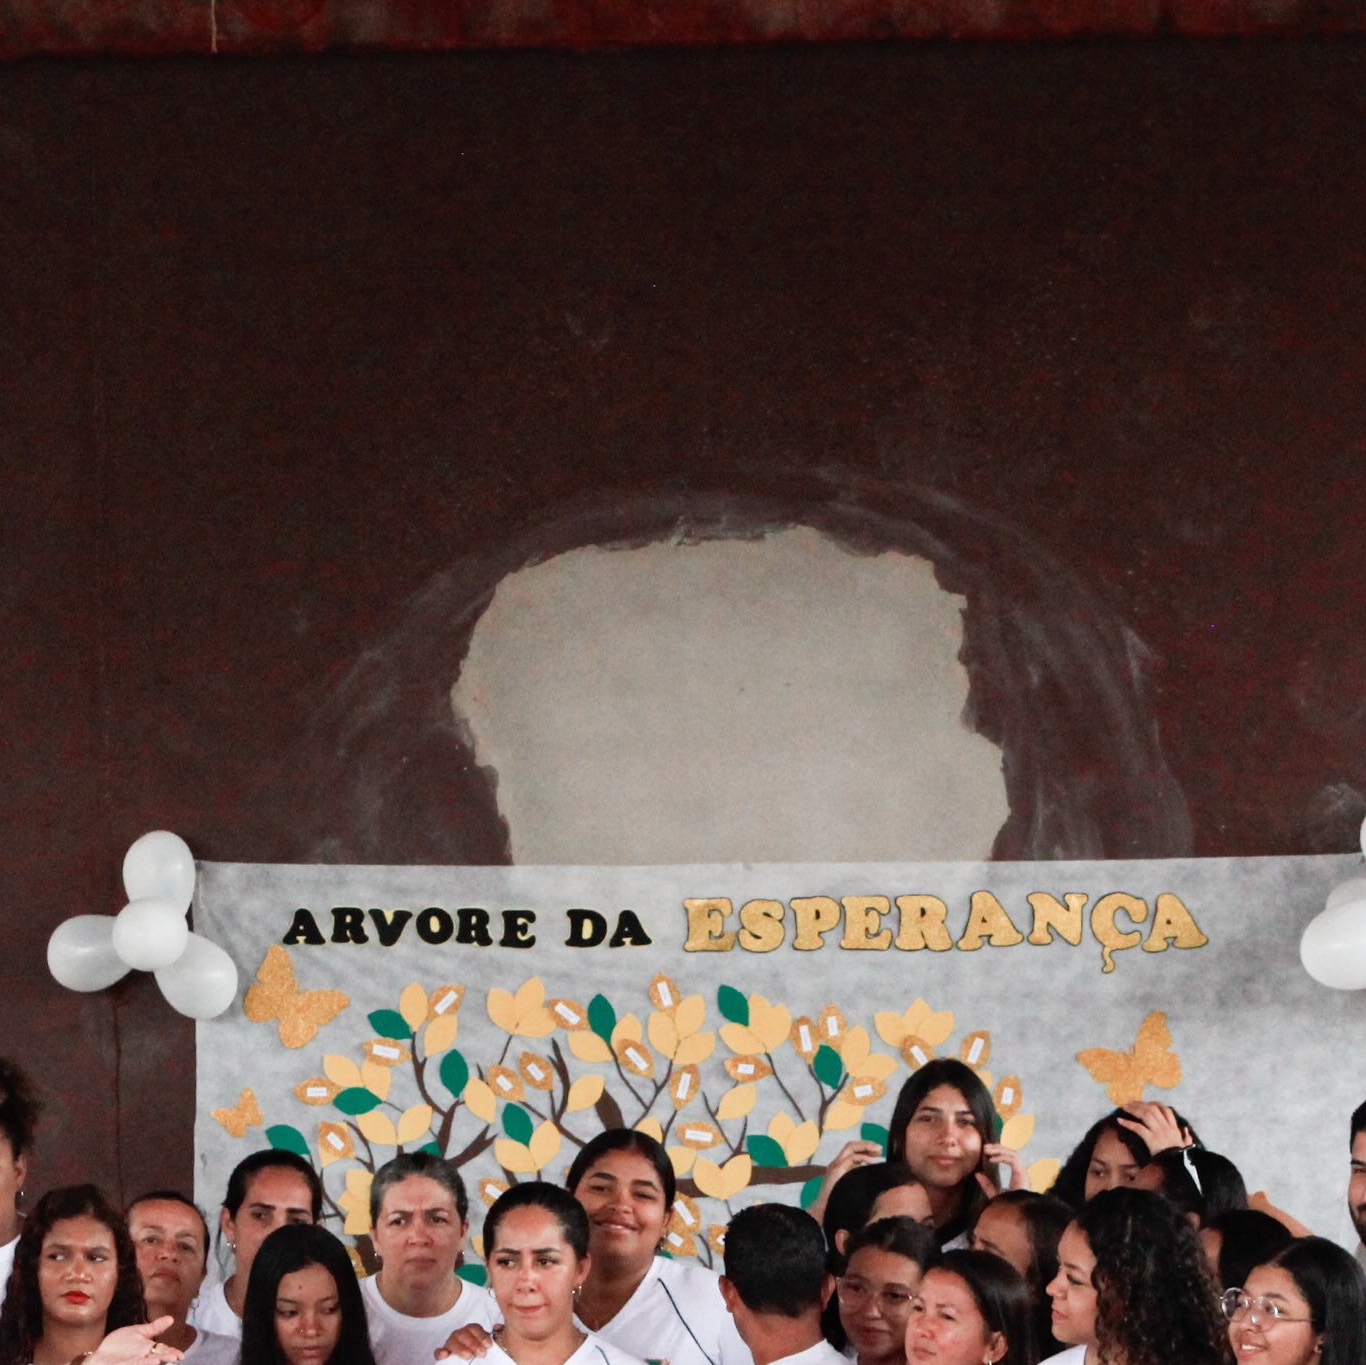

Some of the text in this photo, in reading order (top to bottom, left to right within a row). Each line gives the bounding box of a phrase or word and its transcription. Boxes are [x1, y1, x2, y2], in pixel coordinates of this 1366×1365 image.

[282, 890, 1212, 974] ARVORE DA ESPERANÇA
